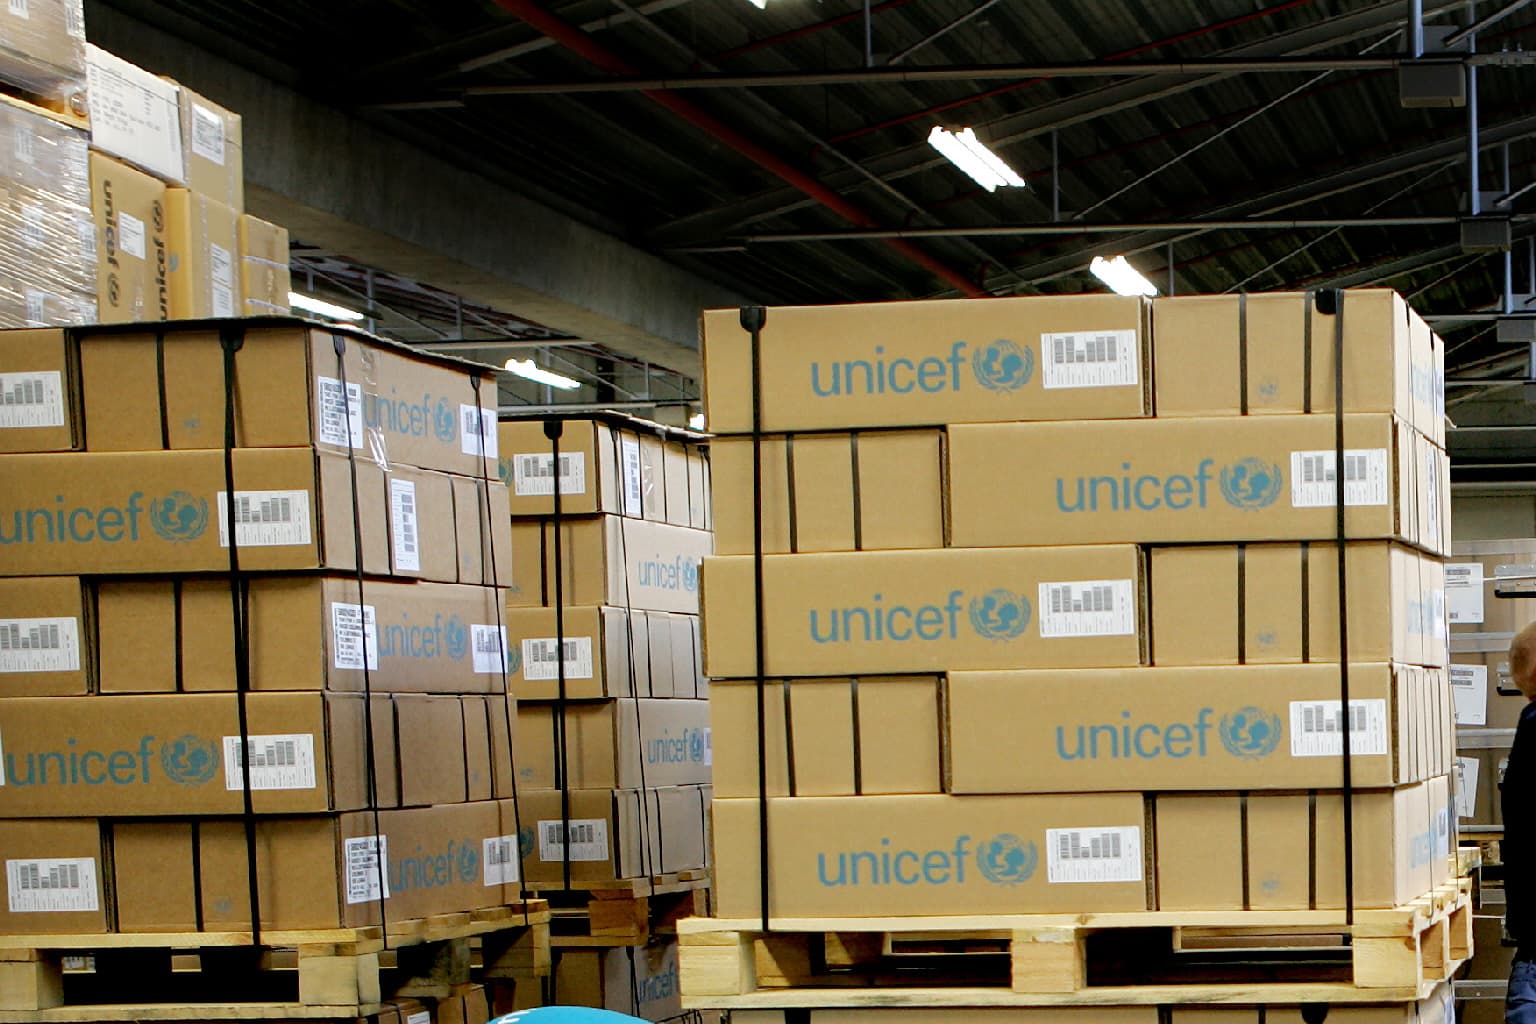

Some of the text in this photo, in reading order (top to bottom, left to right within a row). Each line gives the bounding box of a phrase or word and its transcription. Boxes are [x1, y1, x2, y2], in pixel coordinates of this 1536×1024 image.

[103, 179, 119, 270] unicef
[153, 235, 168, 320] unicef
[811, 341, 966, 398] unicef
[363, 384, 430, 437] unicef
[1056, 458, 1212, 513] unicef
[0, 491, 144, 544] unicef
[638, 554, 681, 590] unicef
[376, 612, 442, 657] unicef
[809, 590, 964, 644] unicef
[7, 735, 155, 786] unicef
[647, 727, 688, 764] unicef
[1055, 708, 1212, 761] unicef
[817, 835, 969, 888] unicef
